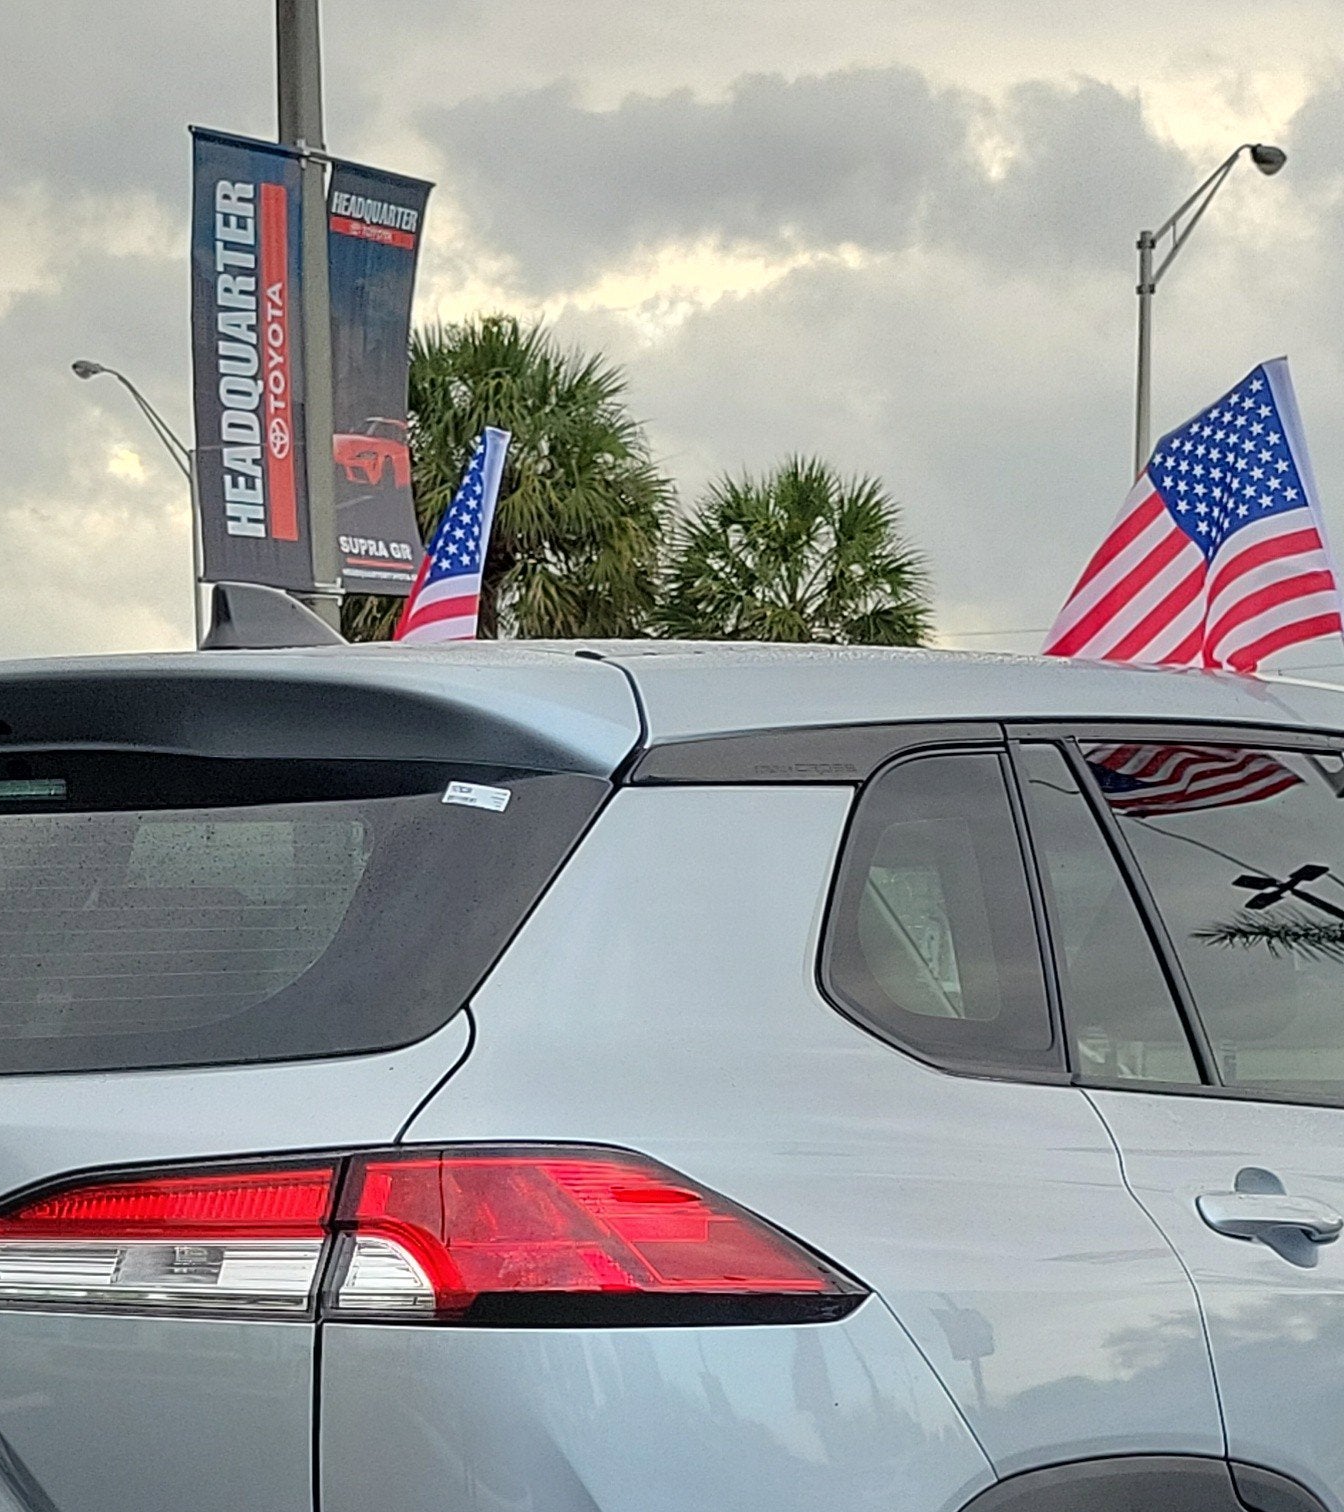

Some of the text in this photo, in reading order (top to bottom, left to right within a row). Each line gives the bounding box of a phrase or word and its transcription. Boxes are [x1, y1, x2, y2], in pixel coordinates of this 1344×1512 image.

[331, 191, 418, 232] HEADQUARTER
[216, 180, 266, 538] HEADQUARTER
[266, 283, 286, 413] TOYOTA
[339, 536, 413, 560] SUPRA GR
